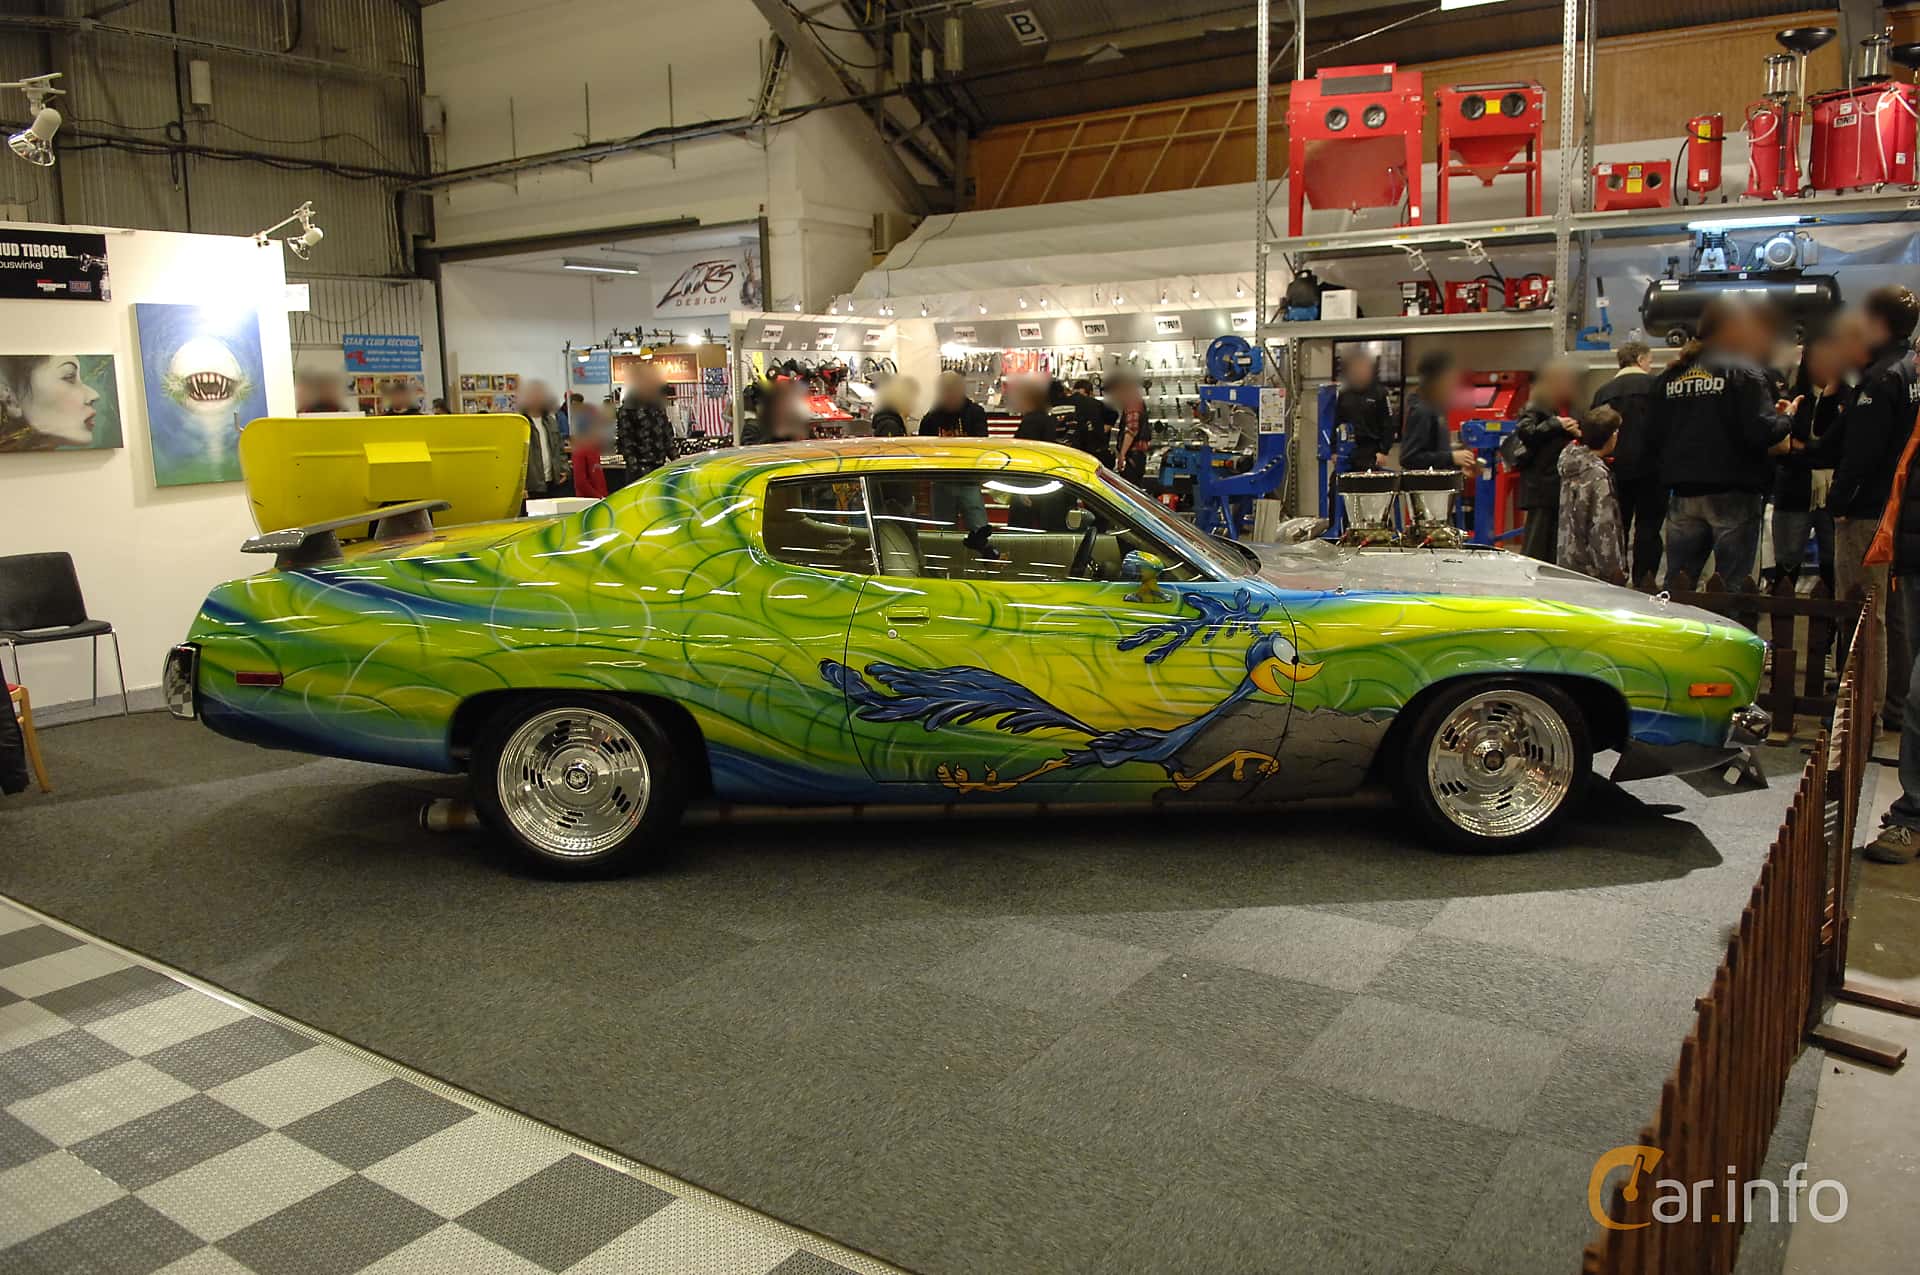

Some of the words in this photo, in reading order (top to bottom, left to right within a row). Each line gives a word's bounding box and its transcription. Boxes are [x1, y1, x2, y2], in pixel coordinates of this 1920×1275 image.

[1010, 15, 1036, 35] B
[21, 243, 67, 259] TIROCH
[675, 296, 727, 307] DESIGN
[1665, 377, 1726, 396] HOTROD
